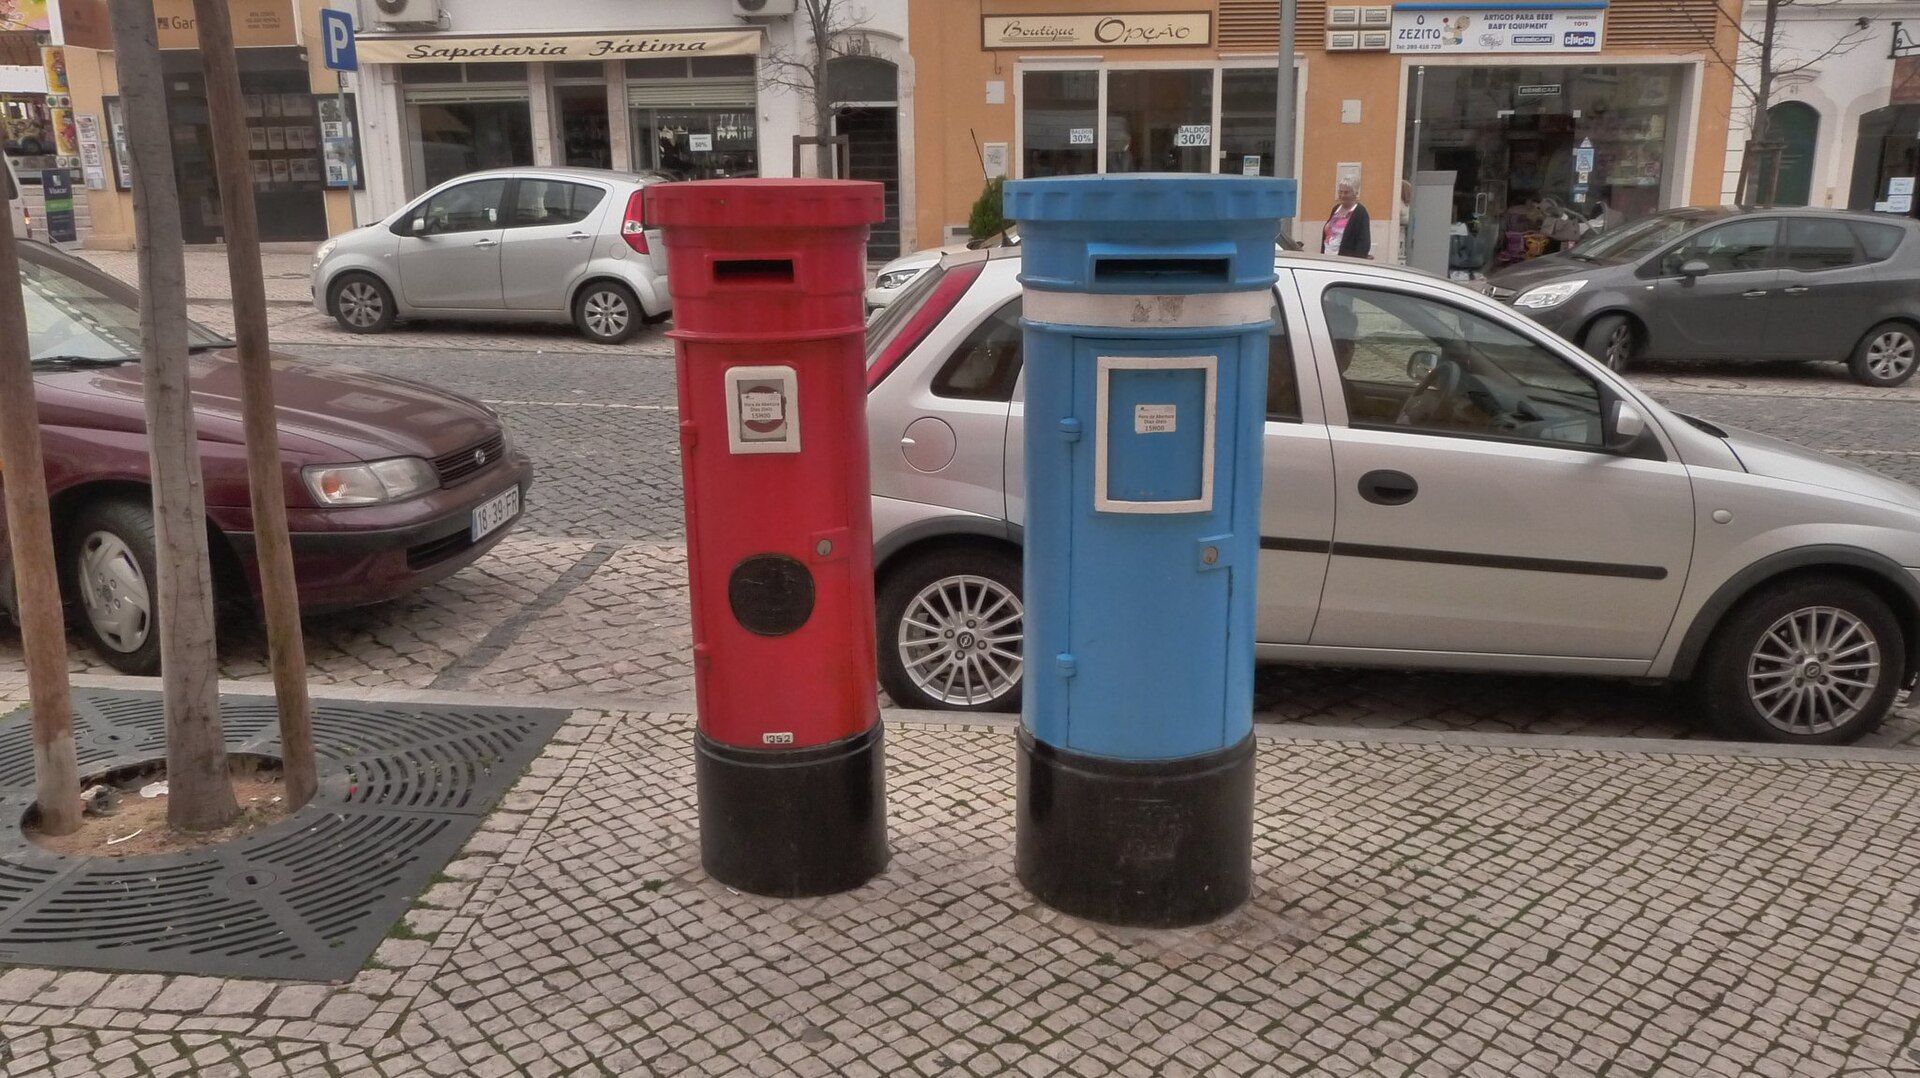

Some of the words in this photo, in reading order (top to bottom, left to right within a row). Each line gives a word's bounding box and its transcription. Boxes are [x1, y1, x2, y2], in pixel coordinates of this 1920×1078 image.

[1483, 13, 1514, 21] ARTIGOS
[1002, 20, 1075, 42] Boutique
[1398, 28, 1441, 40] ZEZITO
[329, 17, 349, 63] P
[406, 42, 568, 61] Sapataria
[588, 38, 707, 57] Fátima
[1072, 134, 1092, 143] 30%
[1181, 133, 1208, 145] 30%
[765, 734, 791, 743] 1352
